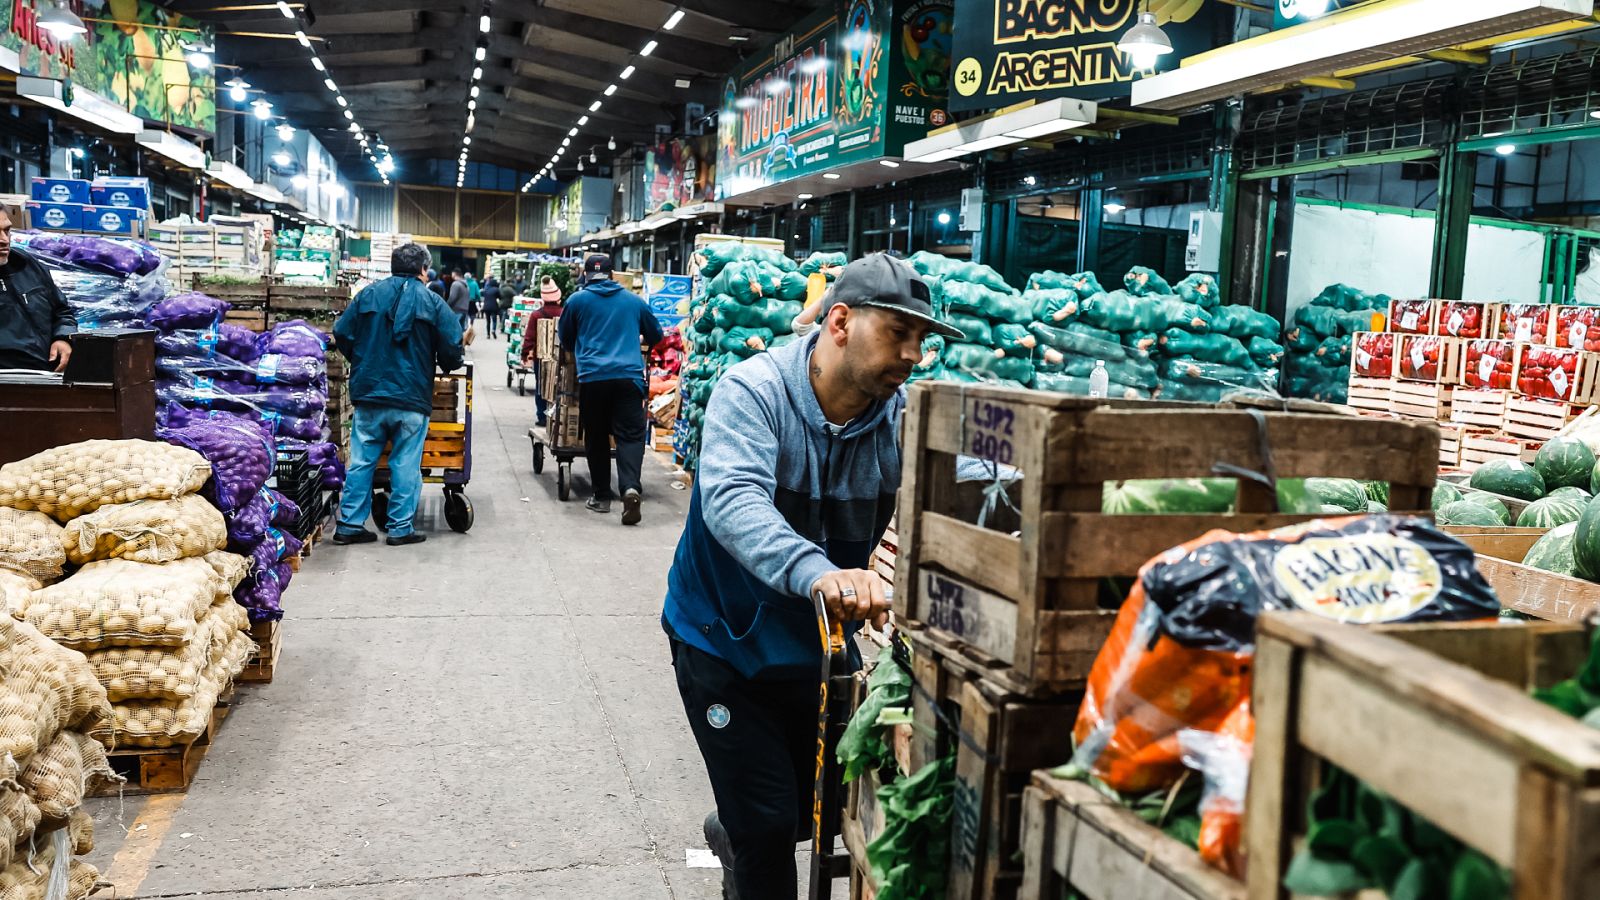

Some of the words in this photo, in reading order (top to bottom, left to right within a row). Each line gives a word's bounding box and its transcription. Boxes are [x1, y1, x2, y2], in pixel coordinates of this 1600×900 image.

[994, 0, 1134, 44] BAGNO
[960, 70, 976, 85] 34
[741, 38, 828, 152] NOGUEIRA
[895, 105, 918, 116] NAVE
[894, 114, 925, 125] PUESTOS
